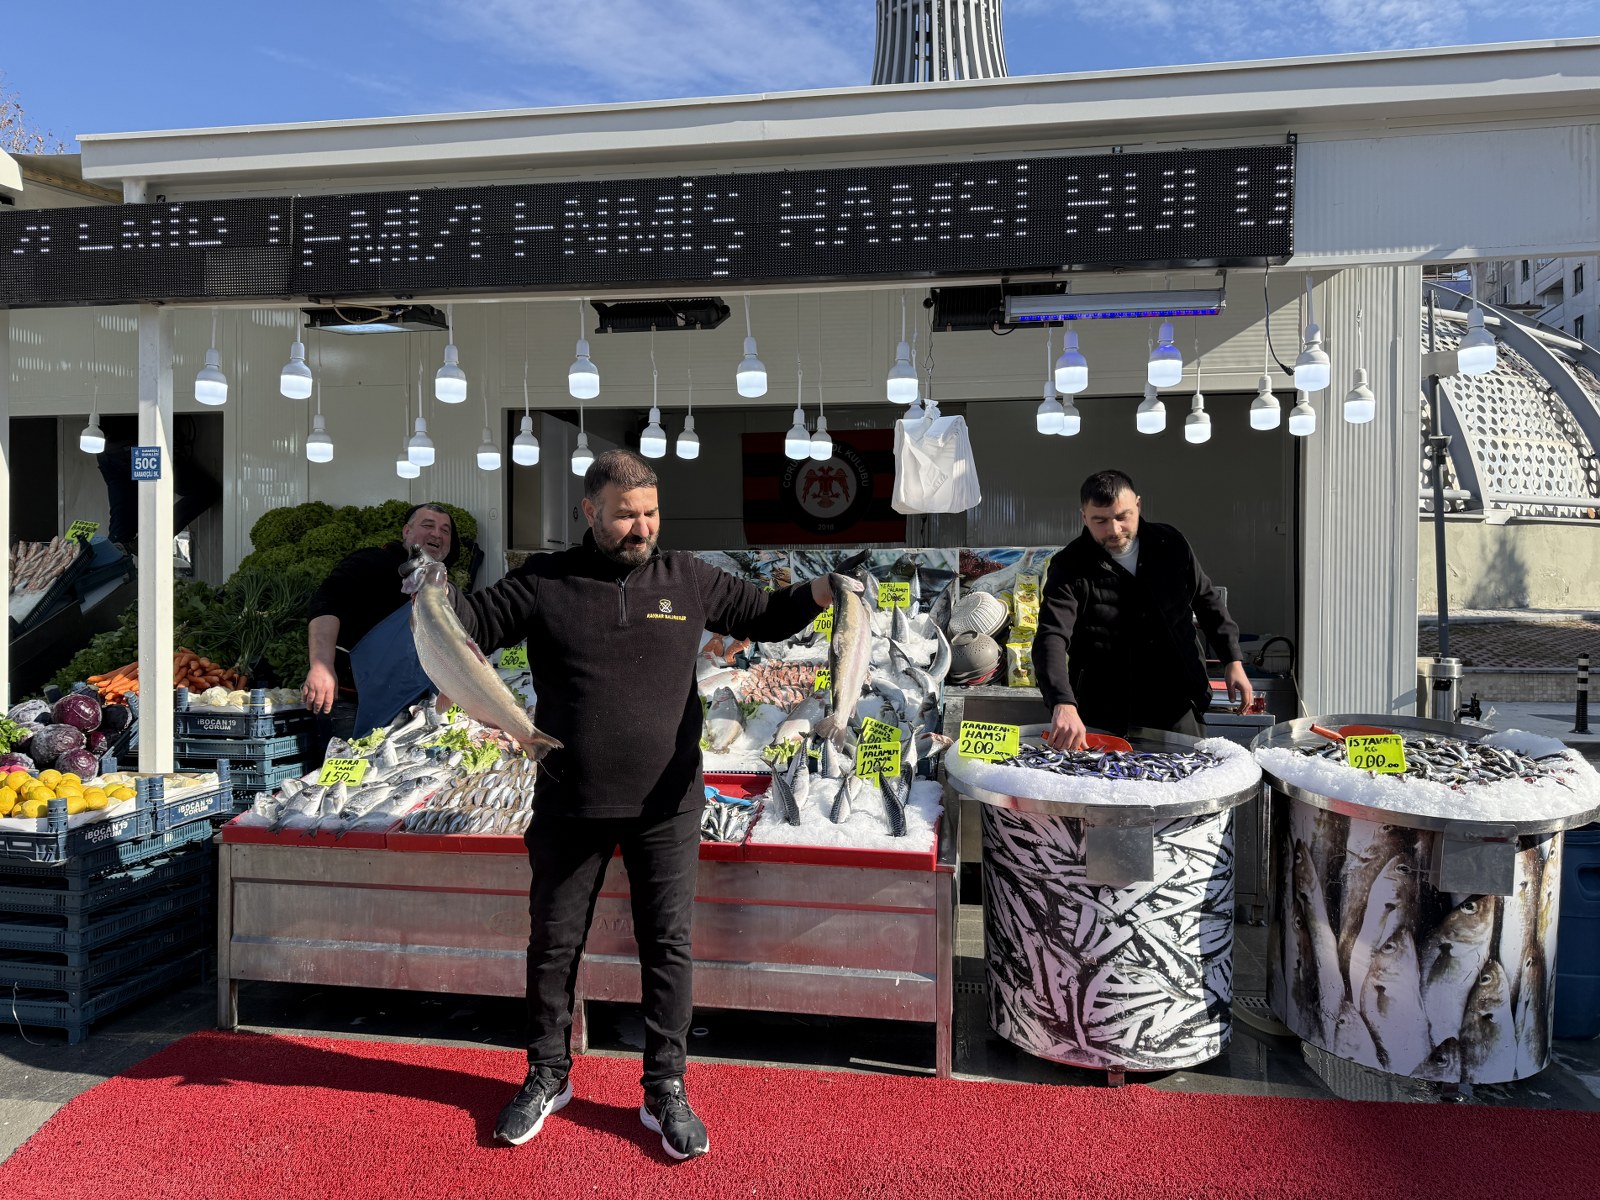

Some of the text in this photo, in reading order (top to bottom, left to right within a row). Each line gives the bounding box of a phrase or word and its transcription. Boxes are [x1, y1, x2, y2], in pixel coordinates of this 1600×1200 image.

[134, 457, 157, 470] 50C
[783, 460, 801, 488] ÇORU
[862, 749, 900, 759] PALAMUT
